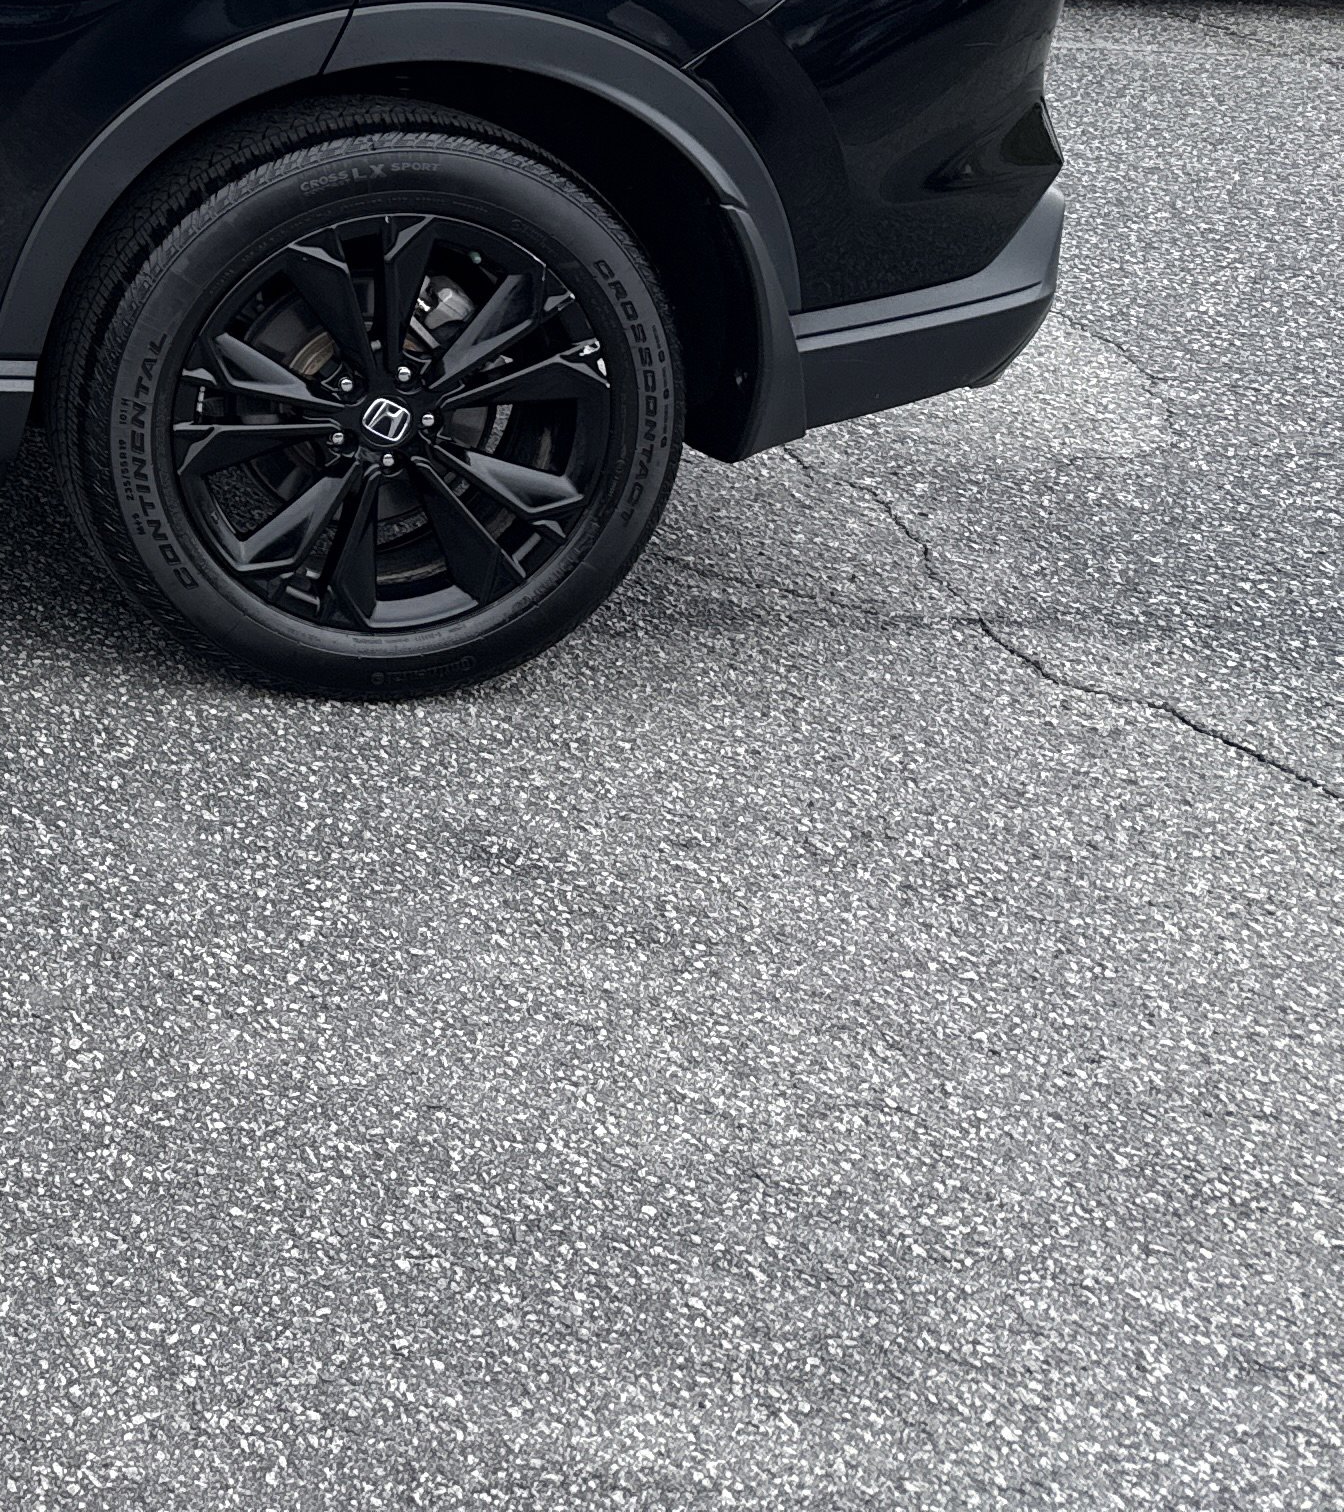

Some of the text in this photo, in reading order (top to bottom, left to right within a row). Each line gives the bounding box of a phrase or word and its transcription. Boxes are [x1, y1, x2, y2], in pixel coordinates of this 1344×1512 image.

[299, 169, 348, 192] CROSS
[390, 161, 440, 173] SPORT
[132, 332, 200, 591] CONTINENTAL
[593, 258, 658, 529] CROSSCONTACT
